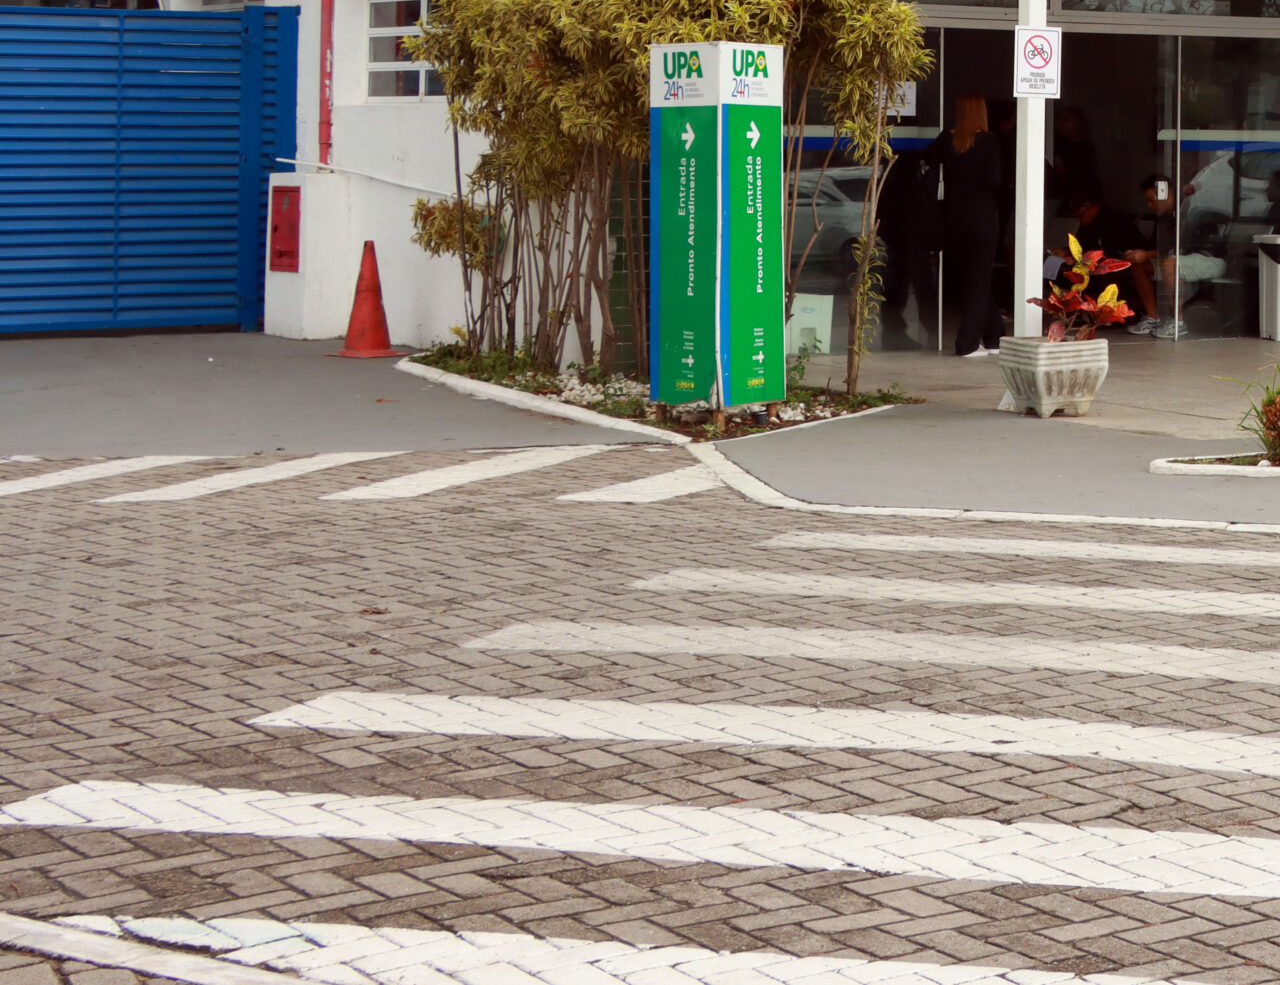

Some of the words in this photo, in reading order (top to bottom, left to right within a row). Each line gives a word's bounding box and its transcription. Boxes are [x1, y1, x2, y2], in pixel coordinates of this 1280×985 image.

[663, 50, 703, 80] UPA
[733, 48, 768, 78] UPA
[664, 80, 684, 101] 24h
[731, 77, 750, 98] 24h
[678, 158, 687, 216] Entrada
[687, 158, 696, 246] Atendimento
[745, 156, 754, 214] Entrada
[755, 156, 764, 243] Atendimento
[687, 249, 695, 296] Pronto
[756, 247, 764, 293] Pronto
